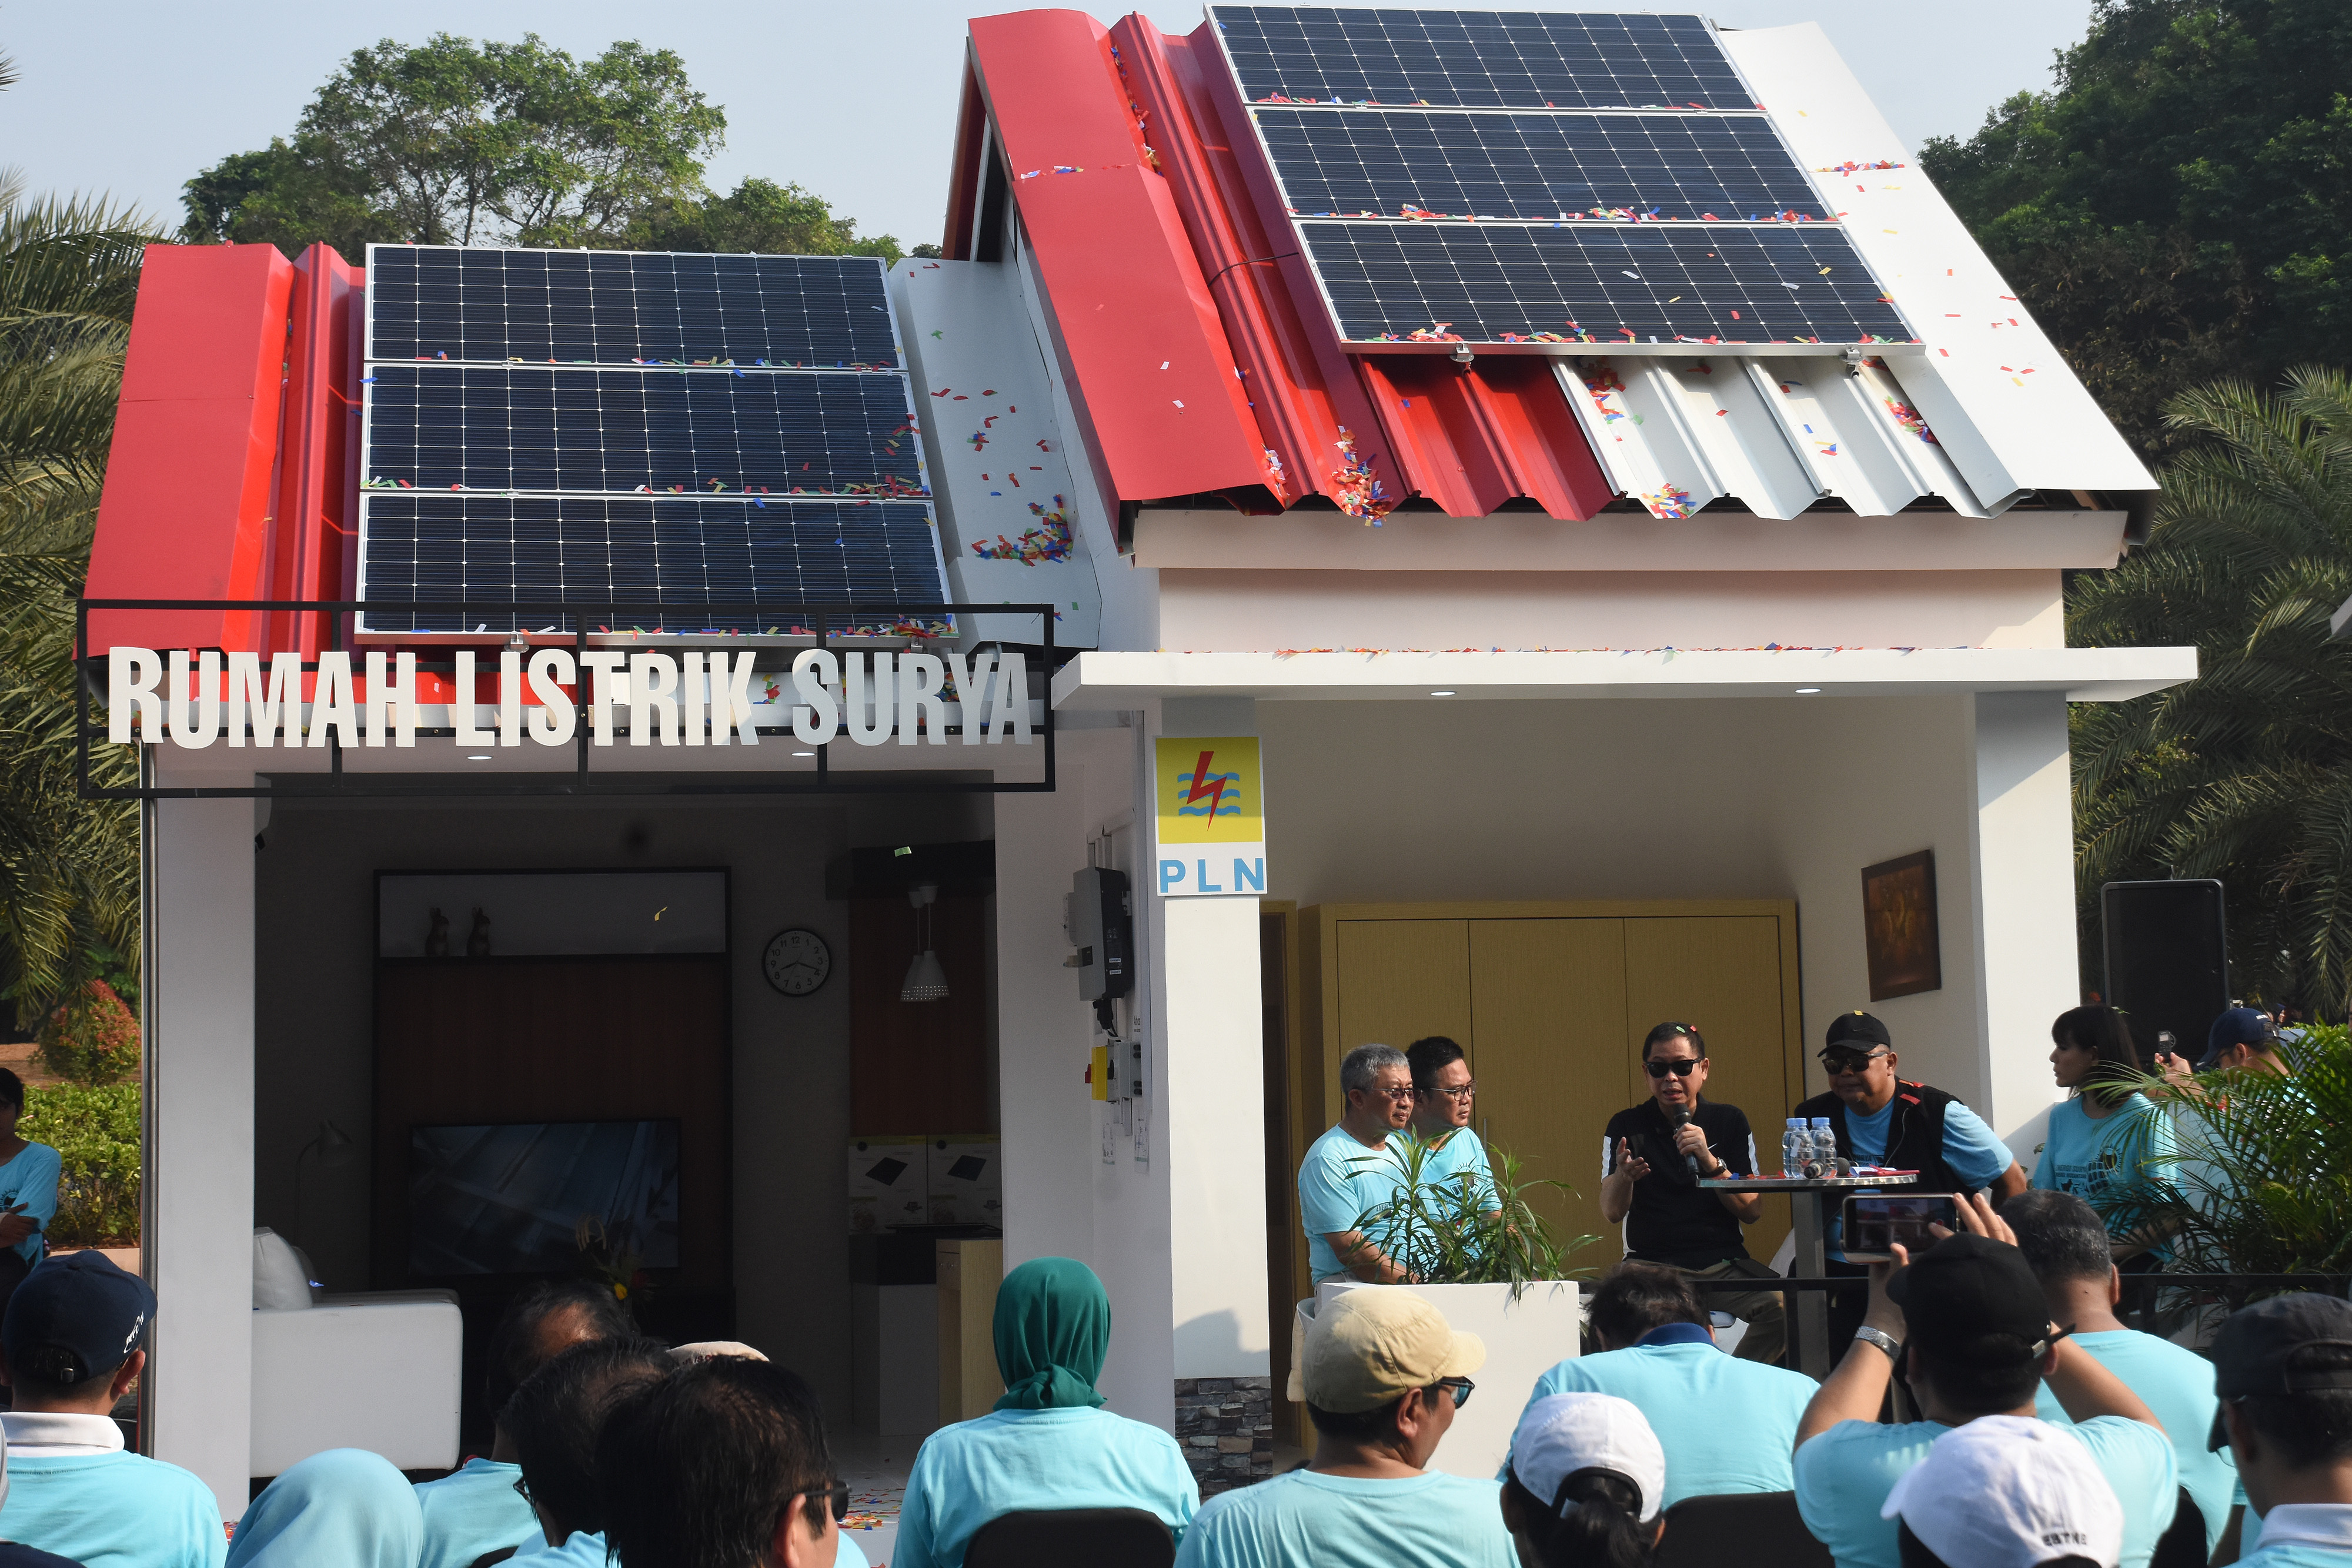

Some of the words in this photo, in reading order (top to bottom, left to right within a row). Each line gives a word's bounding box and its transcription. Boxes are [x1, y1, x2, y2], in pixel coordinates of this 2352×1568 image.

[109, 646, 416, 749] RUMAH
[456, 648, 759, 747] LISTRIK
[791, 648, 1033, 747] SURYA
[1159, 857, 1264, 893] PLN
[814, 946, 819, 954] 2
[774, 971, 780, 979] 8
[795, 981, 801, 989] 6
